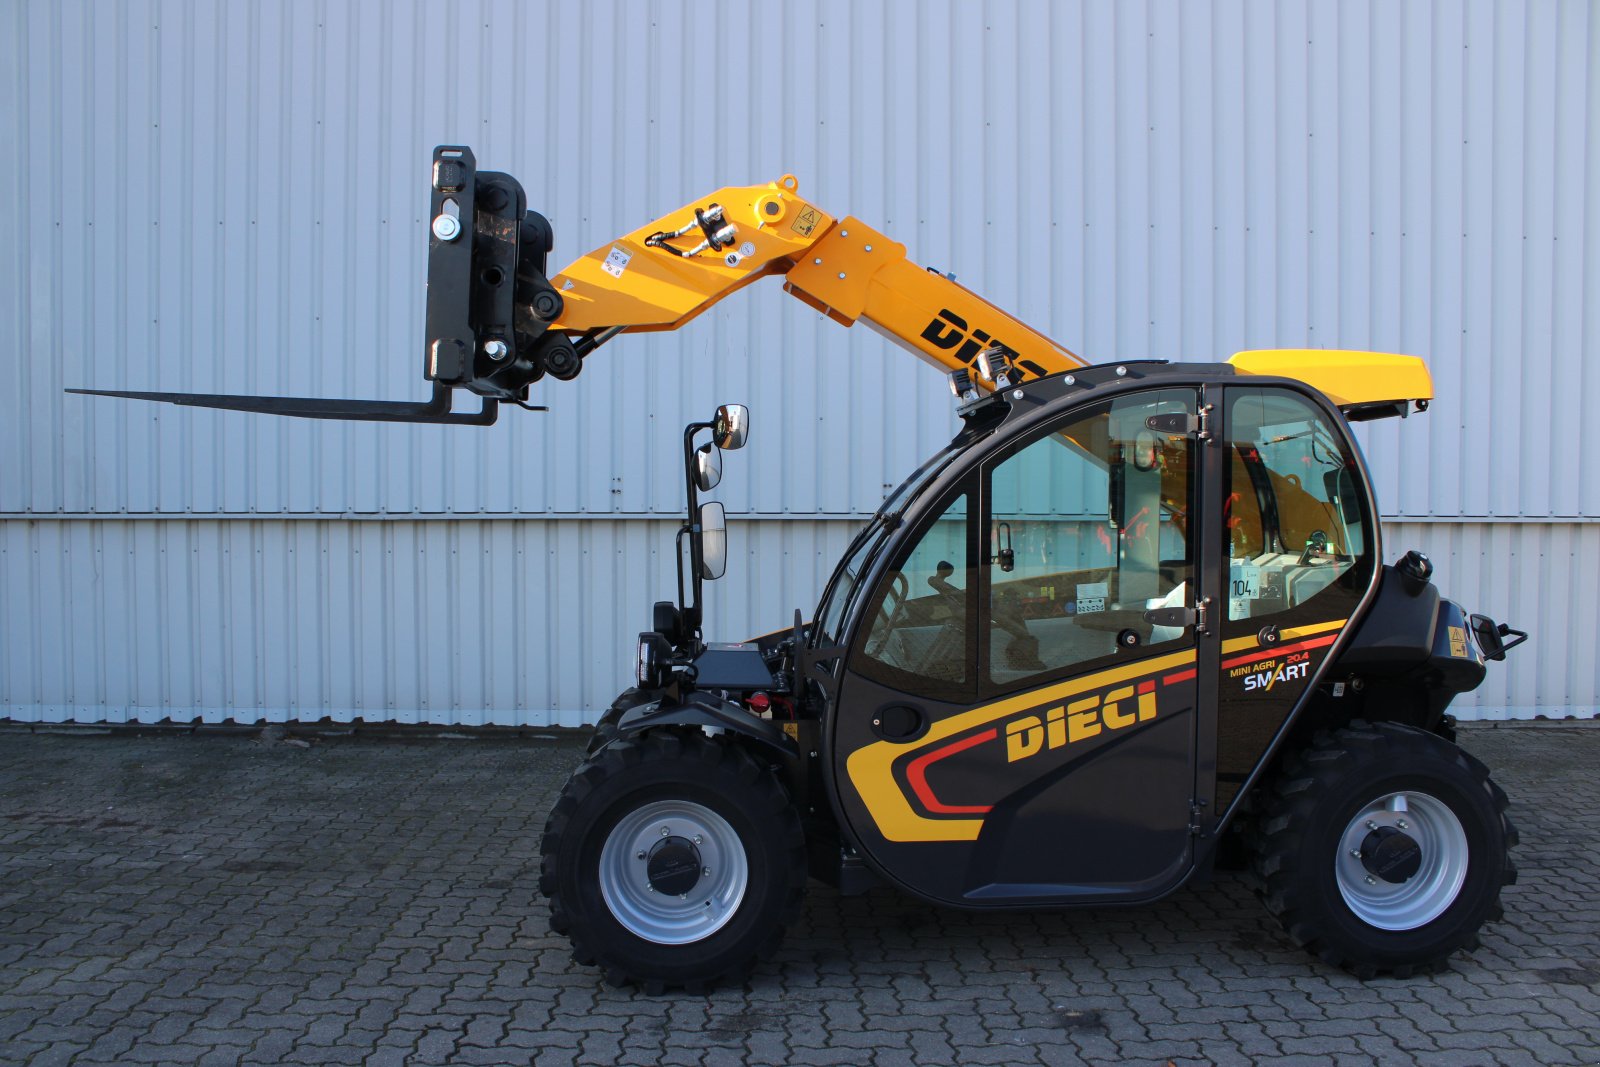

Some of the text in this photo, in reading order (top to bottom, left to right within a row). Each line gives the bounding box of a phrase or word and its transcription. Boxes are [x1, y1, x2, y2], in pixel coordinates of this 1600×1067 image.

[1233, 580, 1251, 596] 104
[1230, 651, 1309, 678] MINI AGRI 20.4
[1244, 661, 1310, 691] SMART
[1005, 679, 1157, 763] DIECI
